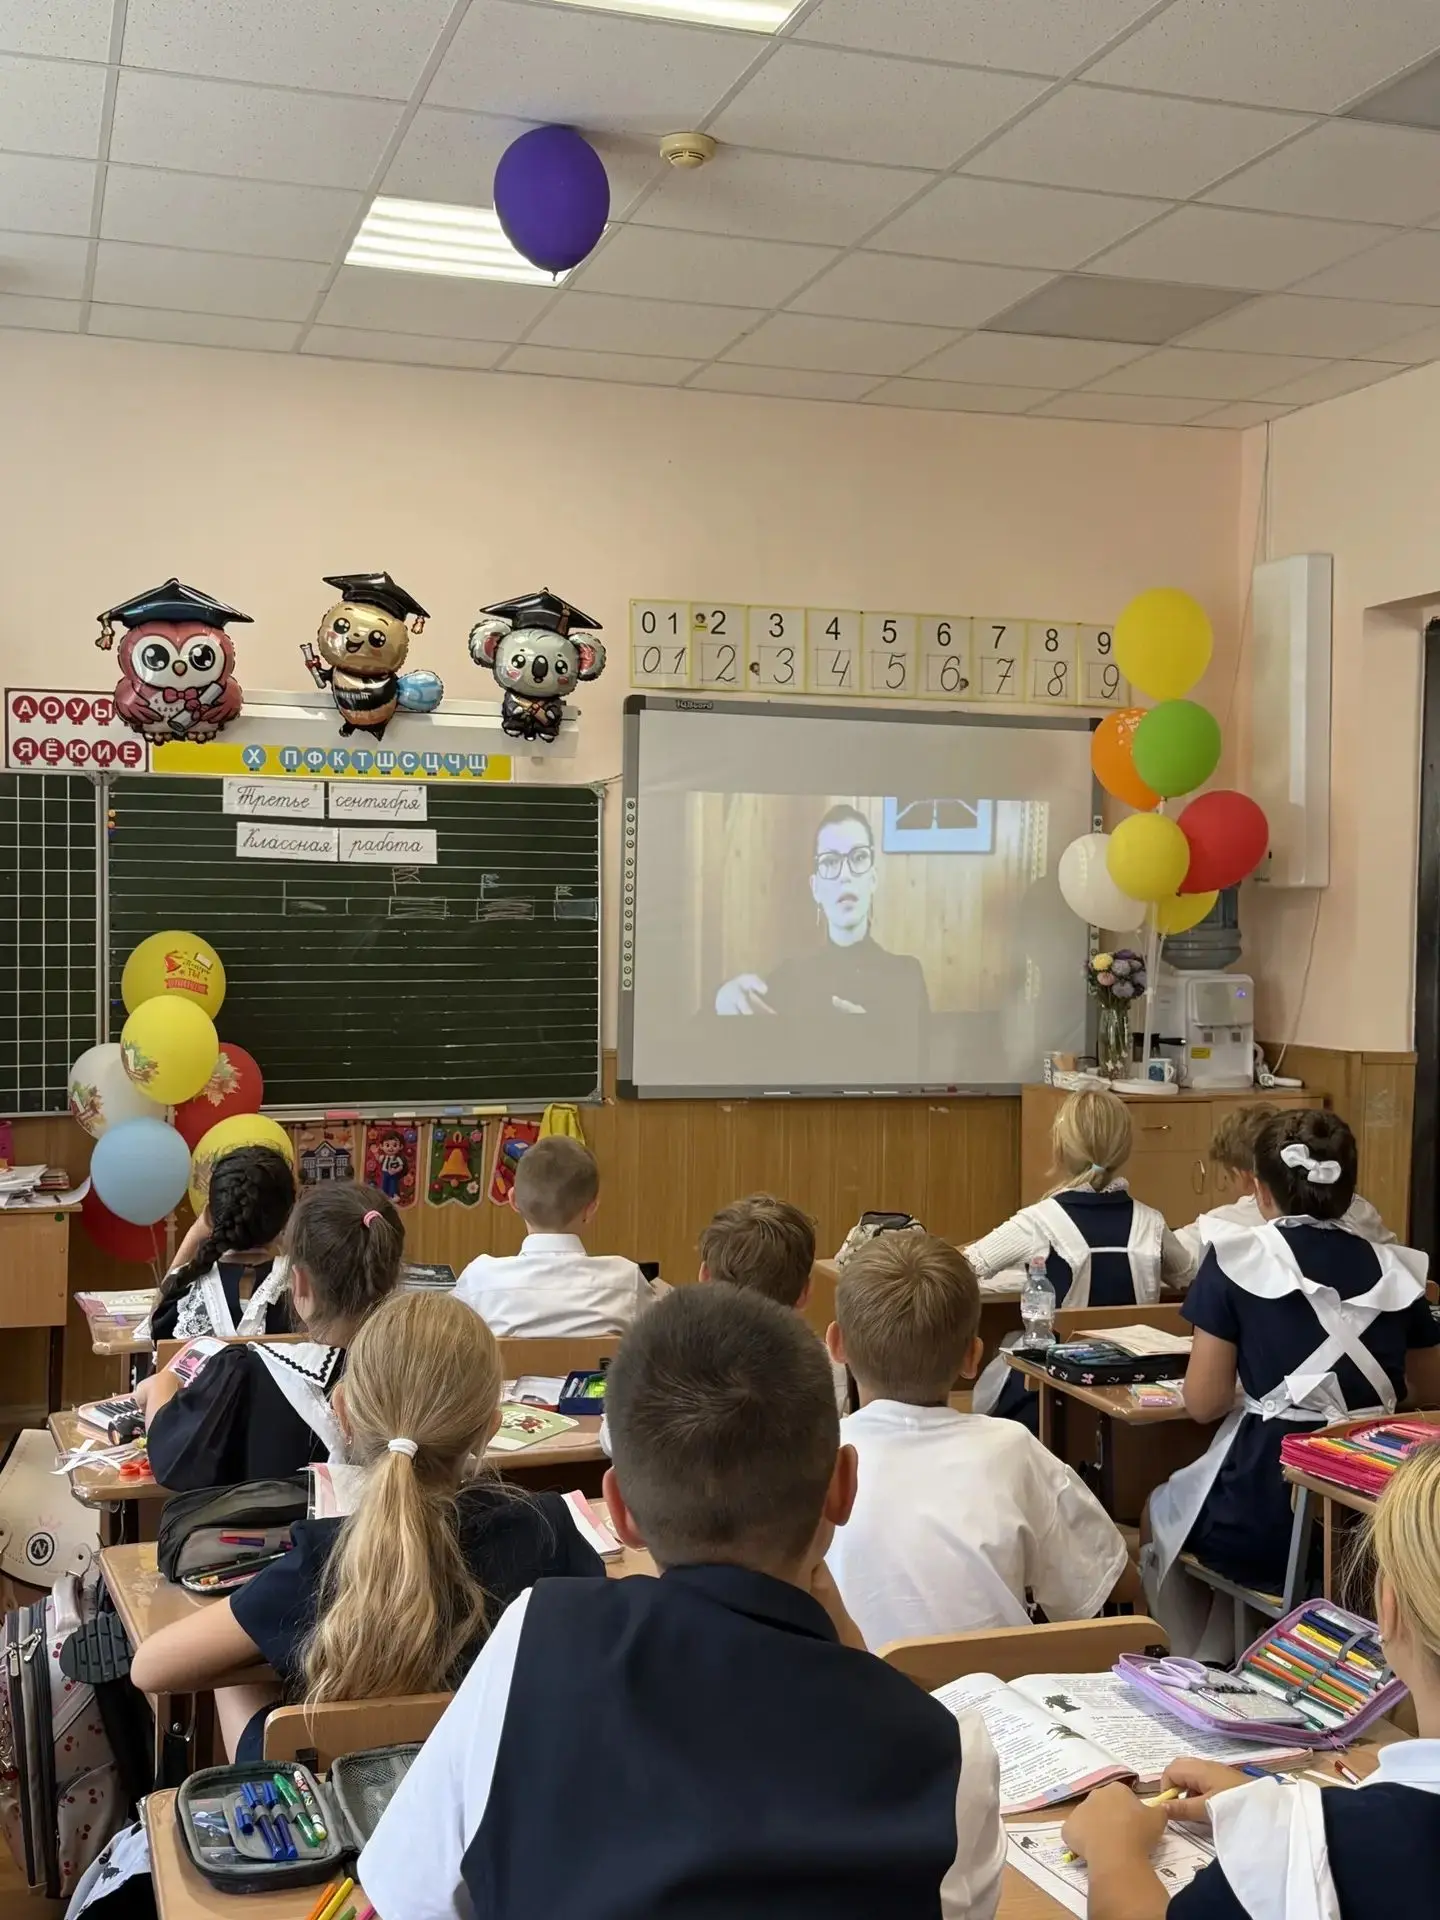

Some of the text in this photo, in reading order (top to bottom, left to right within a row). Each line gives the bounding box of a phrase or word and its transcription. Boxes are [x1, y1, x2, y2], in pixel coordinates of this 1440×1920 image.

[642, 610, 1111, 655] 0 1 2 3 4 5 6 7 8 9
[642, 645, 1120, 699] 0 1 2 3 4 5 6 7 8 9
[237, 785, 421, 817] Третье сентября
[242, 828, 424, 859] Классная работа
